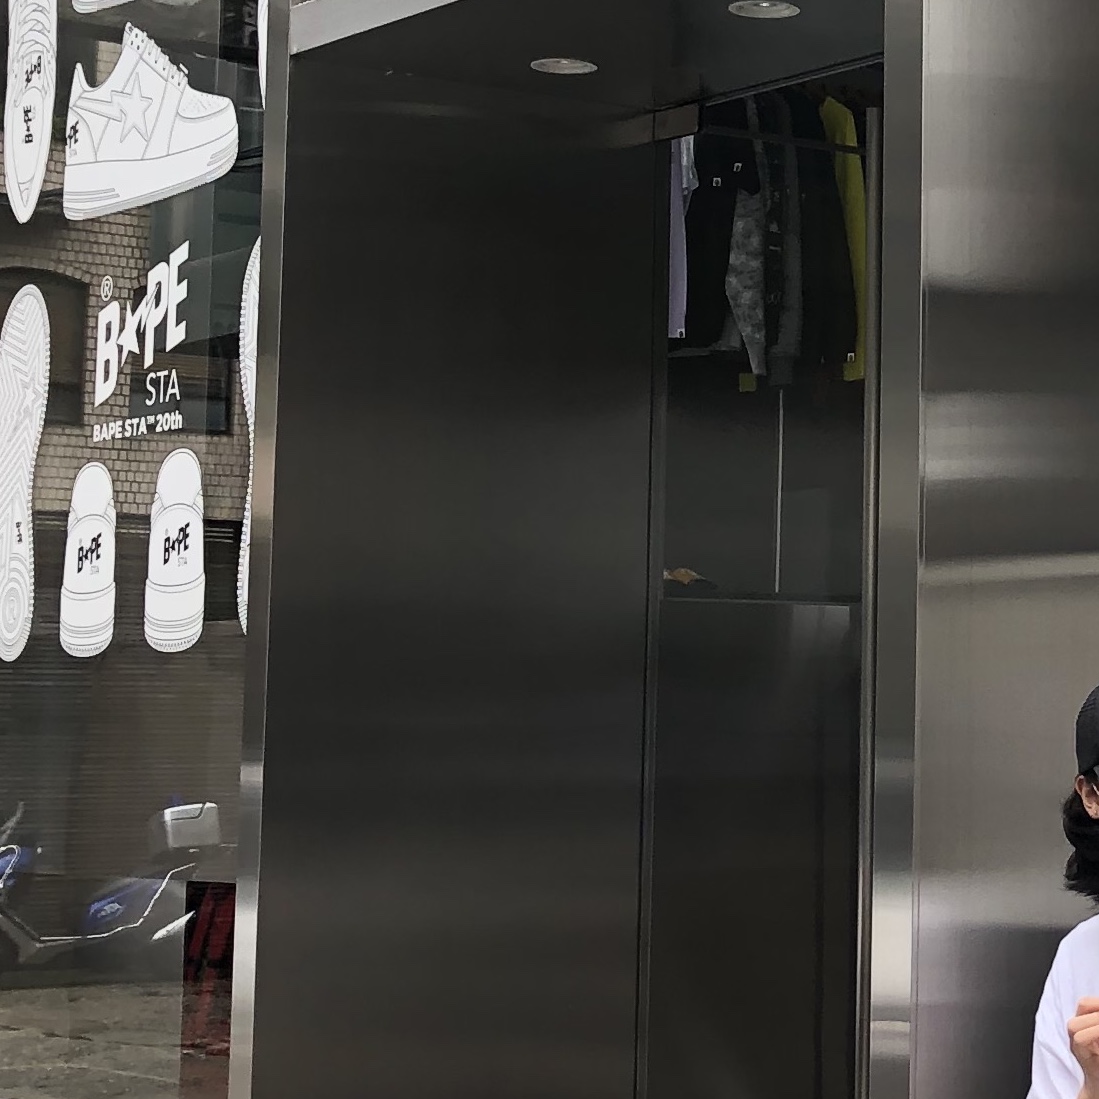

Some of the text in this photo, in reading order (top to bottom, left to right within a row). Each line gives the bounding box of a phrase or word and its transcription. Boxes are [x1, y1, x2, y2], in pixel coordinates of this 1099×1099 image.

[94, 240, 190, 408] BAPE
[145, 369, 181, 406] STA
[93, 420, 123, 443] BAPE
[155, 410, 183, 433] 20th
